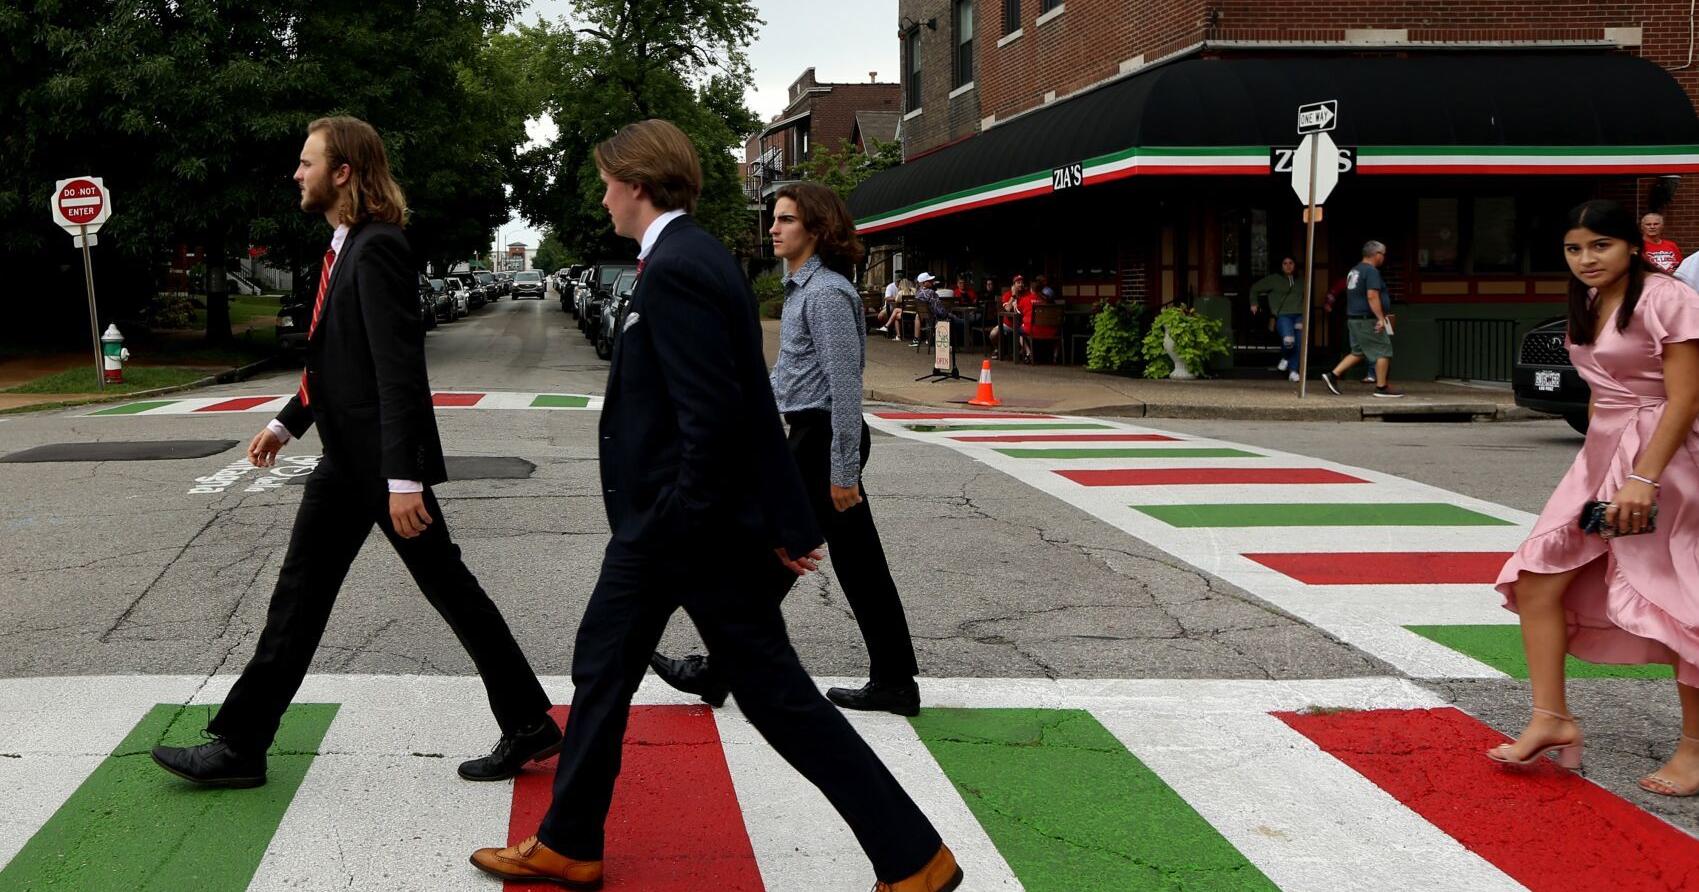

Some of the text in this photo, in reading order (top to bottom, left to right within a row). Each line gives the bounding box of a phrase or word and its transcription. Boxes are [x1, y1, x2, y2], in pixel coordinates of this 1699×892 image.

[1301, 110, 1328, 125] ONE WAY
[1053, 164, 1082, 190] ZIA'S
[64, 187, 96, 197] DO NOT
[68, 207, 94, 217] ENTER
